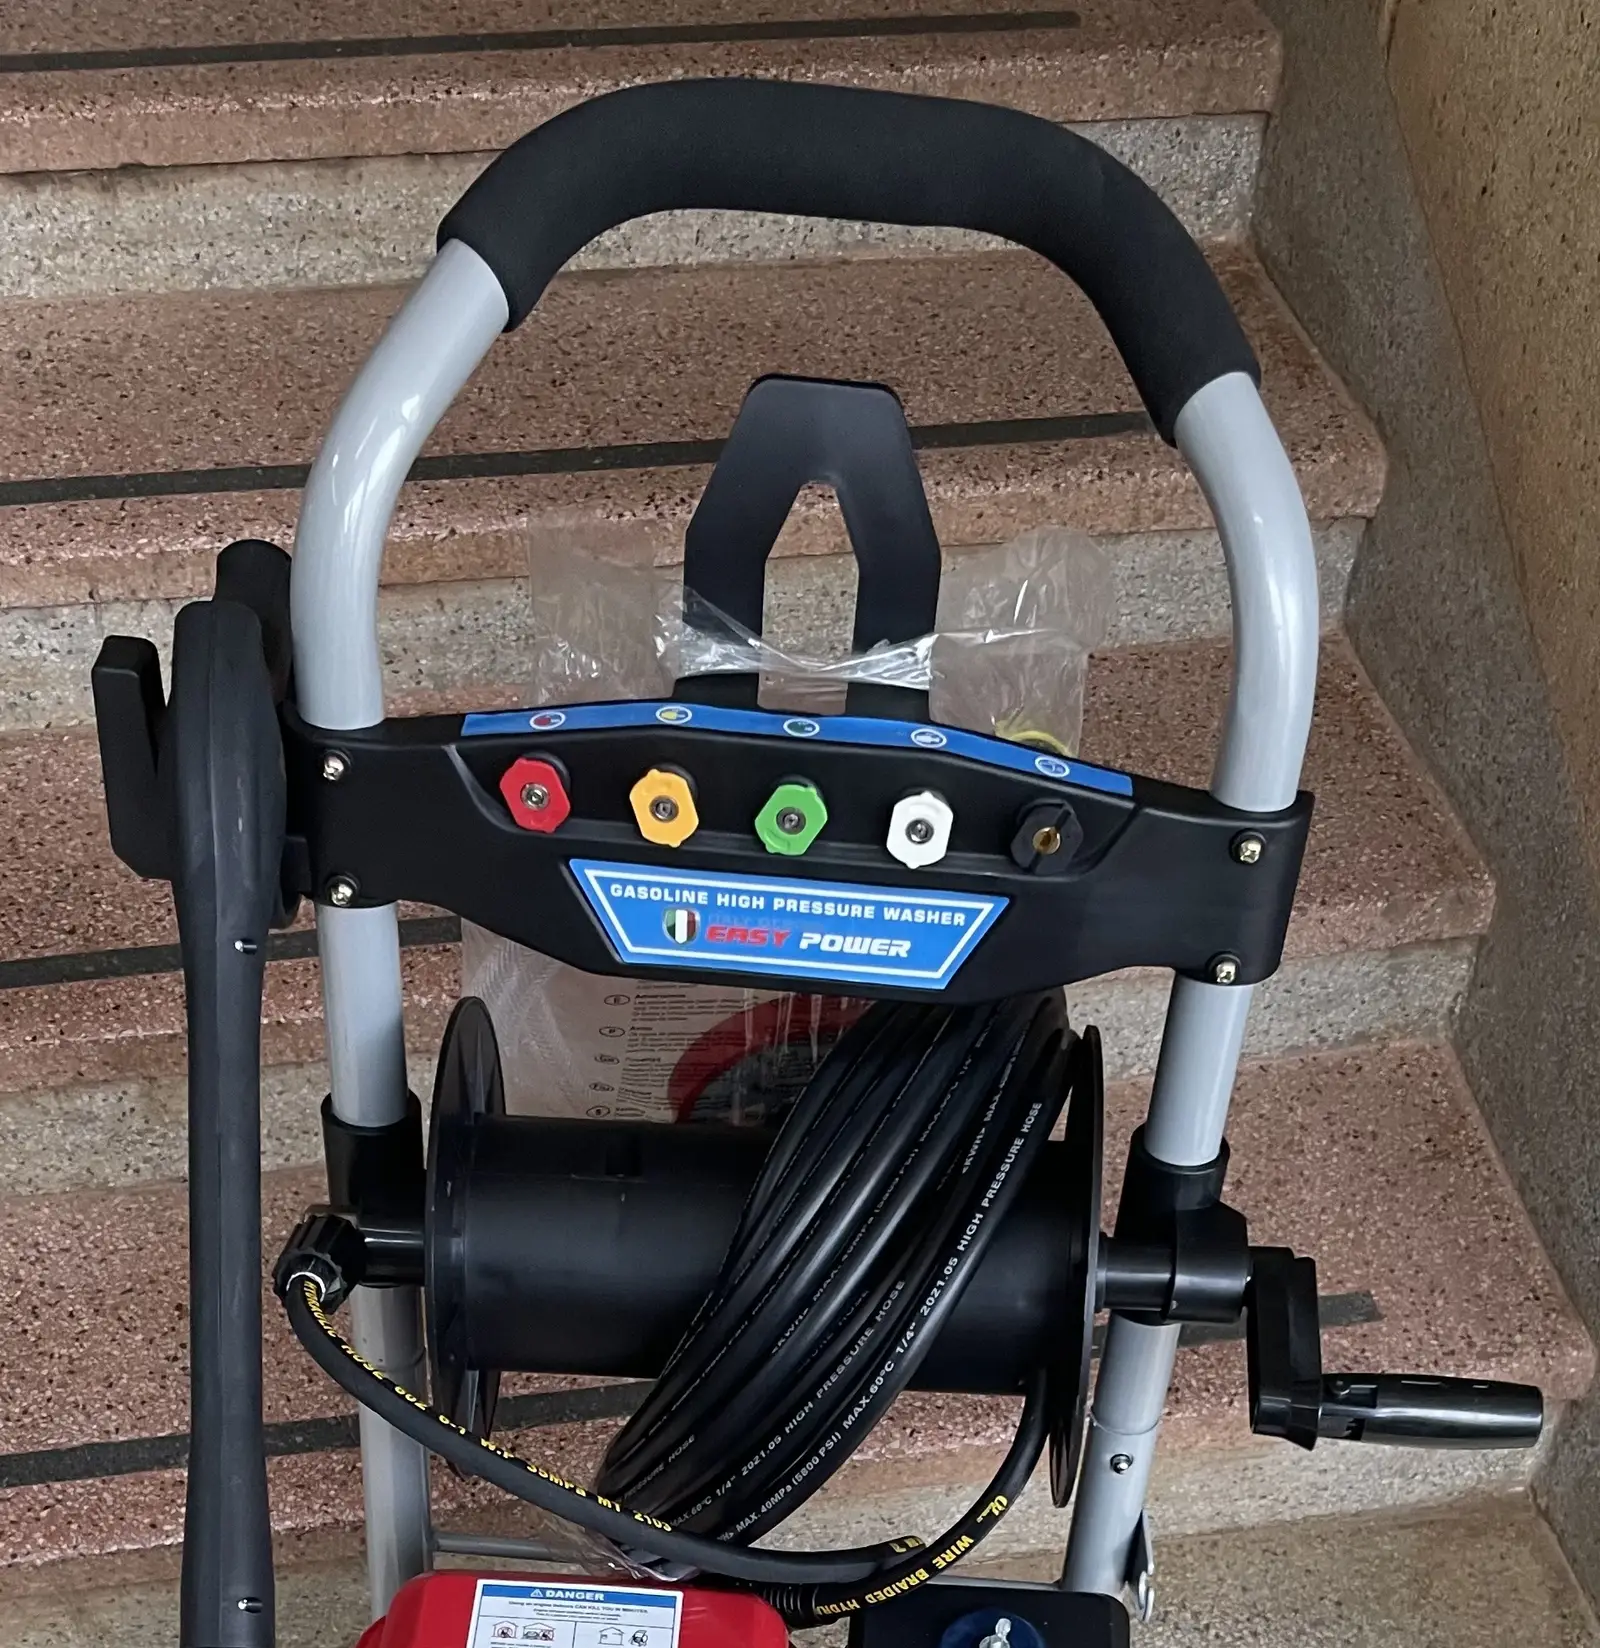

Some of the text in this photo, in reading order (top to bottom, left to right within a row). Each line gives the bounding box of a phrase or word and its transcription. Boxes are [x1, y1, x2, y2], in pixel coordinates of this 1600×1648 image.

[610, 883, 966, 926] GASOLINE HIGH PRESSURE WASHER
[704, 924, 912, 958] EASY POWER
[920, 1257, 958, 1316] 2021.05
[957, 1213, 984, 1251] HIGH
[981, 1137, 1025, 1207] PRESSURE
[1020, 1102, 1042, 1133] HOSE
[785, 1401, 814, 1434] HIGH
[816, 1327, 875, 1399] PRESSURE
[875, 1280, 906, 1323] HOSE
[931, 1534, 975, 1570] WIRE
[545, 1590, 605, 1601] DANGER
[865, 1568, 930, 1605] BRAIDED
